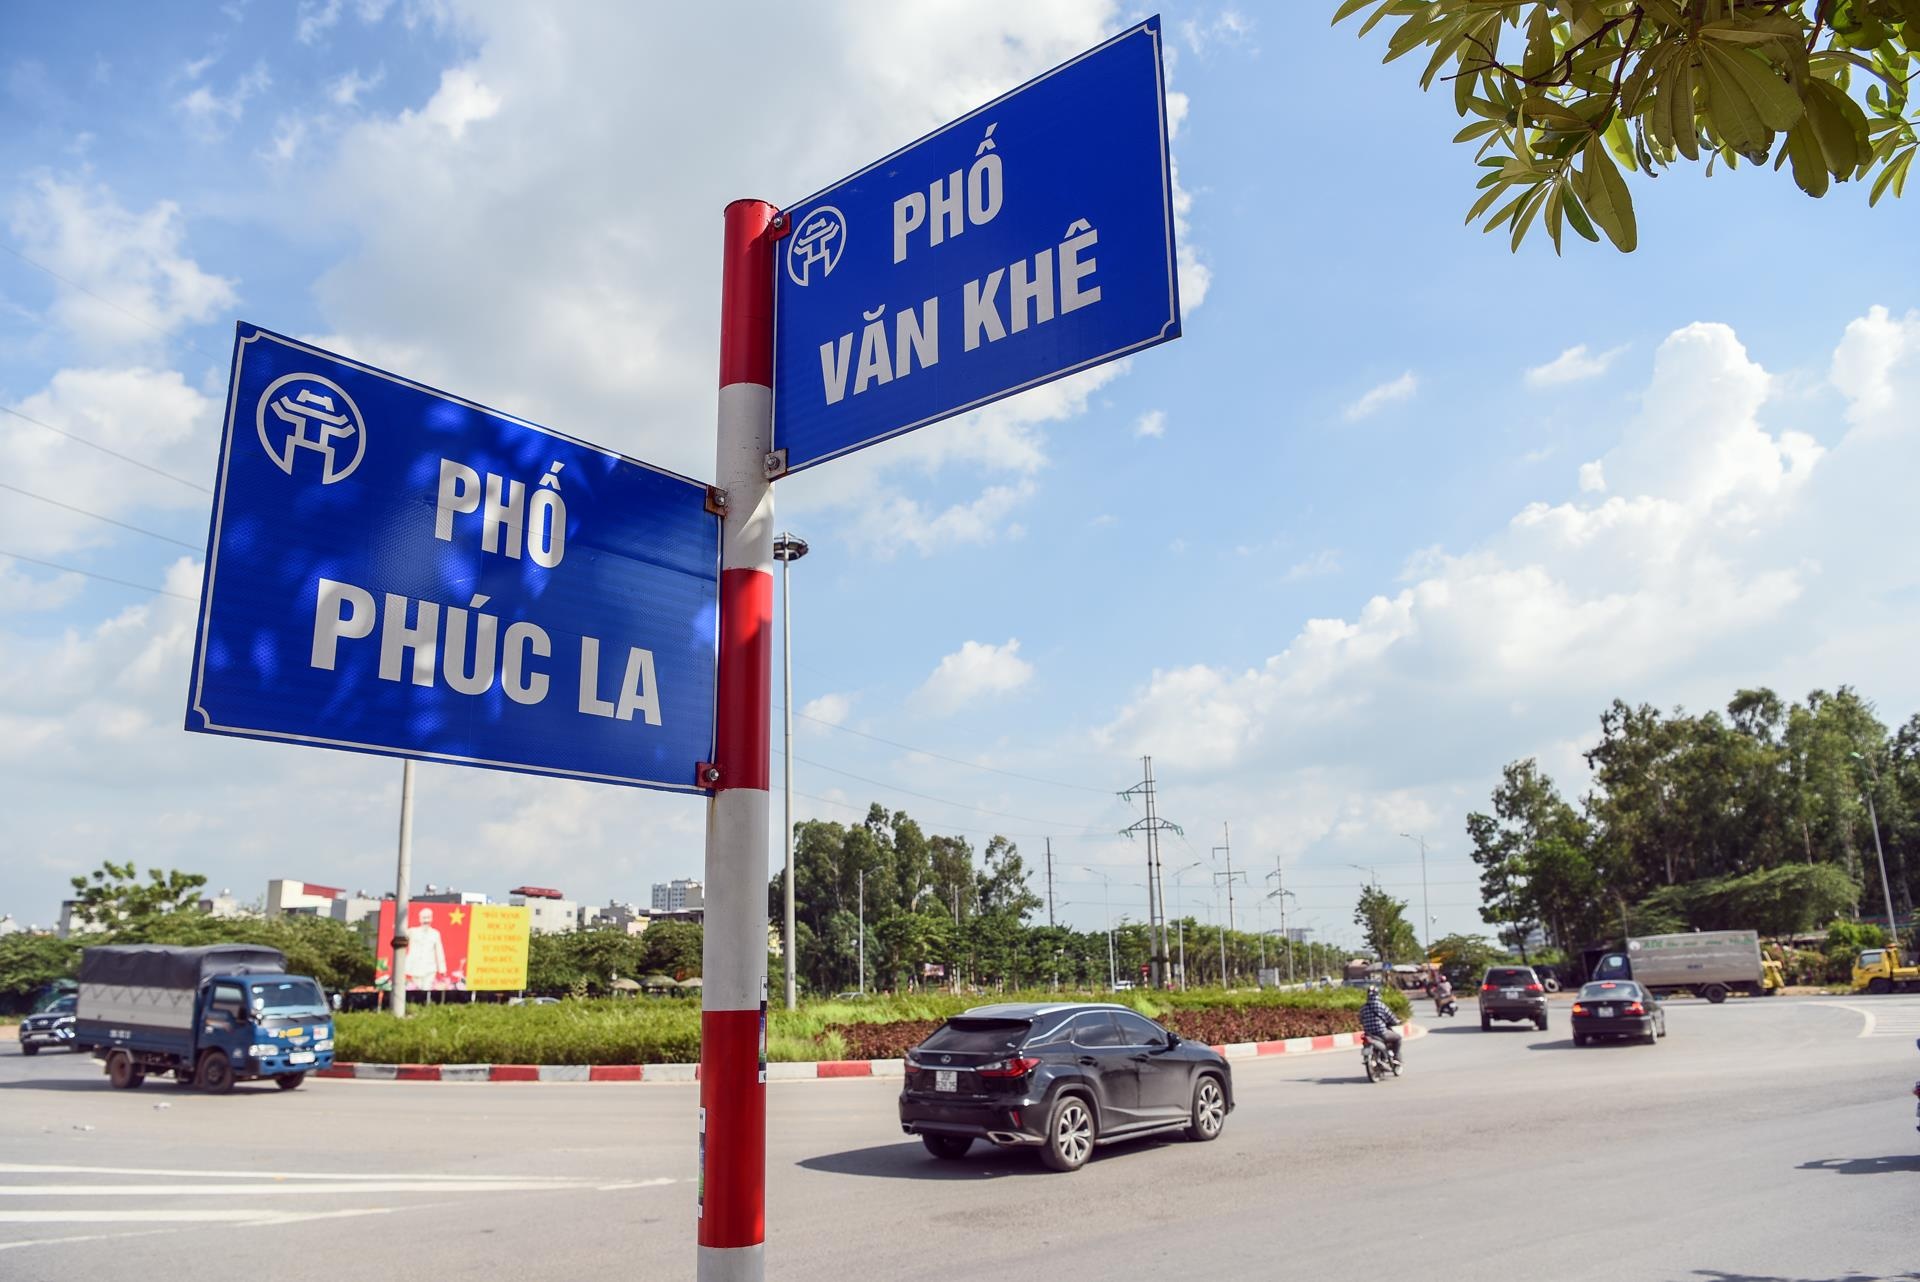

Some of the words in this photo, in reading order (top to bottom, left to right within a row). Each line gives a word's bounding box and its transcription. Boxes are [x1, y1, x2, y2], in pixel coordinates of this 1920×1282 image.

[893, 122, 1004, 266] PHỐ
[819, 296, 939, 406] VĂN
[963, 217, 1101, 353] KHÊ
[434, 457, 567, 570] PHỐ
[310, 577, 552, 706] PHÚC
[578, 635, 663, 727] LA
